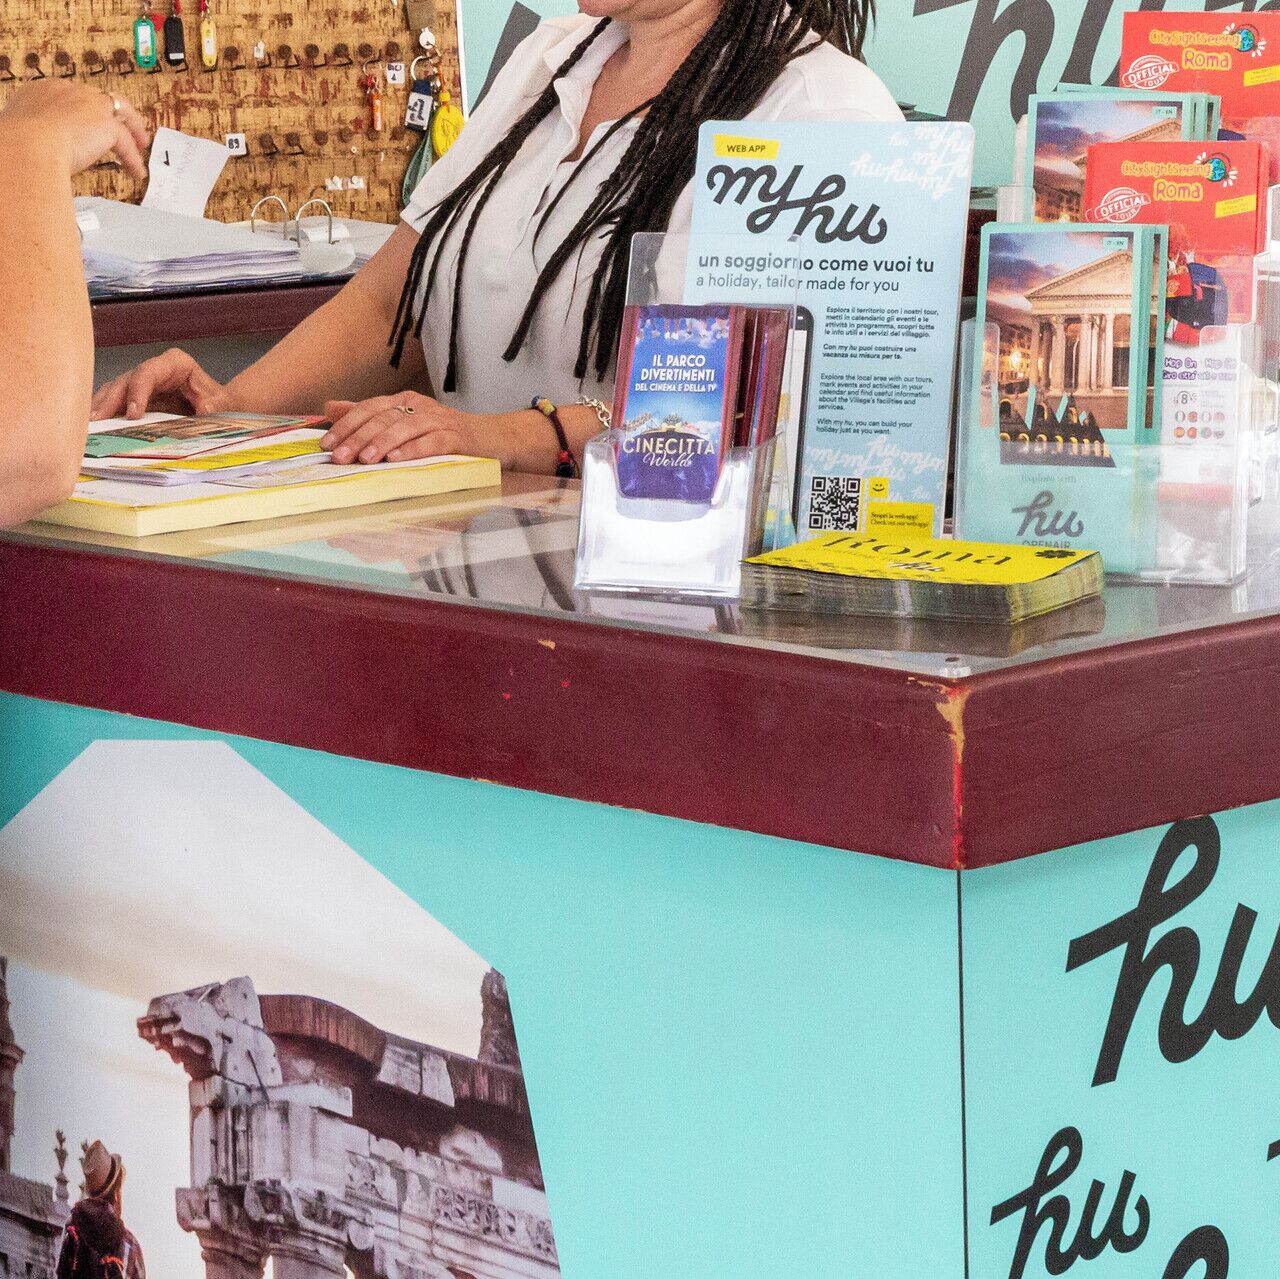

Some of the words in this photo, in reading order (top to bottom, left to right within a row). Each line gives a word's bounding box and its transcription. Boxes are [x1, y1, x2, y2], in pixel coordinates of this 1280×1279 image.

[1128, 62, 1174, 85] OFFICIAL
[1144, 76, 1165, 87] TOUR
[727, 144, 747, 153] WEB
[748, 144, 766, 153] APP
[1100, 195, 1147, 217] OFFICIAL
[1115, 209, 1137, 220] TOUR
[699, 255, 719, 268] un
[724, 253, 814, 272] soggiorno
[819, 258, 868, 271] come
[873, 257, 911, 272] vuoi
[916, 258, 934, 272] tu
[696, 277, 704, 286] a
[708, 274, 761, 289] holiday,
[766, 274, 803, 289] tailor
[807, 276, 845, 290] made
[850, 276, 870, 291] for
[874, 279, 899, 294] you
[653, 355, 662, 366] IL
[666, 355, 705, 367] PARCO
[1165, 357, 1183, 369] Hop
[1185, 357, 1197, 368] On
[640, 369, 715, 381] DIVERTIMENTI
[635, 383, 647, 391] DEL
[650, 383, 676, 391] CINEMA
[684, 384, 705, 392] DELLA
[708, 384, 717, 392] TV
[643, 449, 695, 467] World
[1012, 490, 1084, 538] hu
[1022, 540, 1071, 548] OPENAIR
[989, 1125, 1151, 1279] hu
